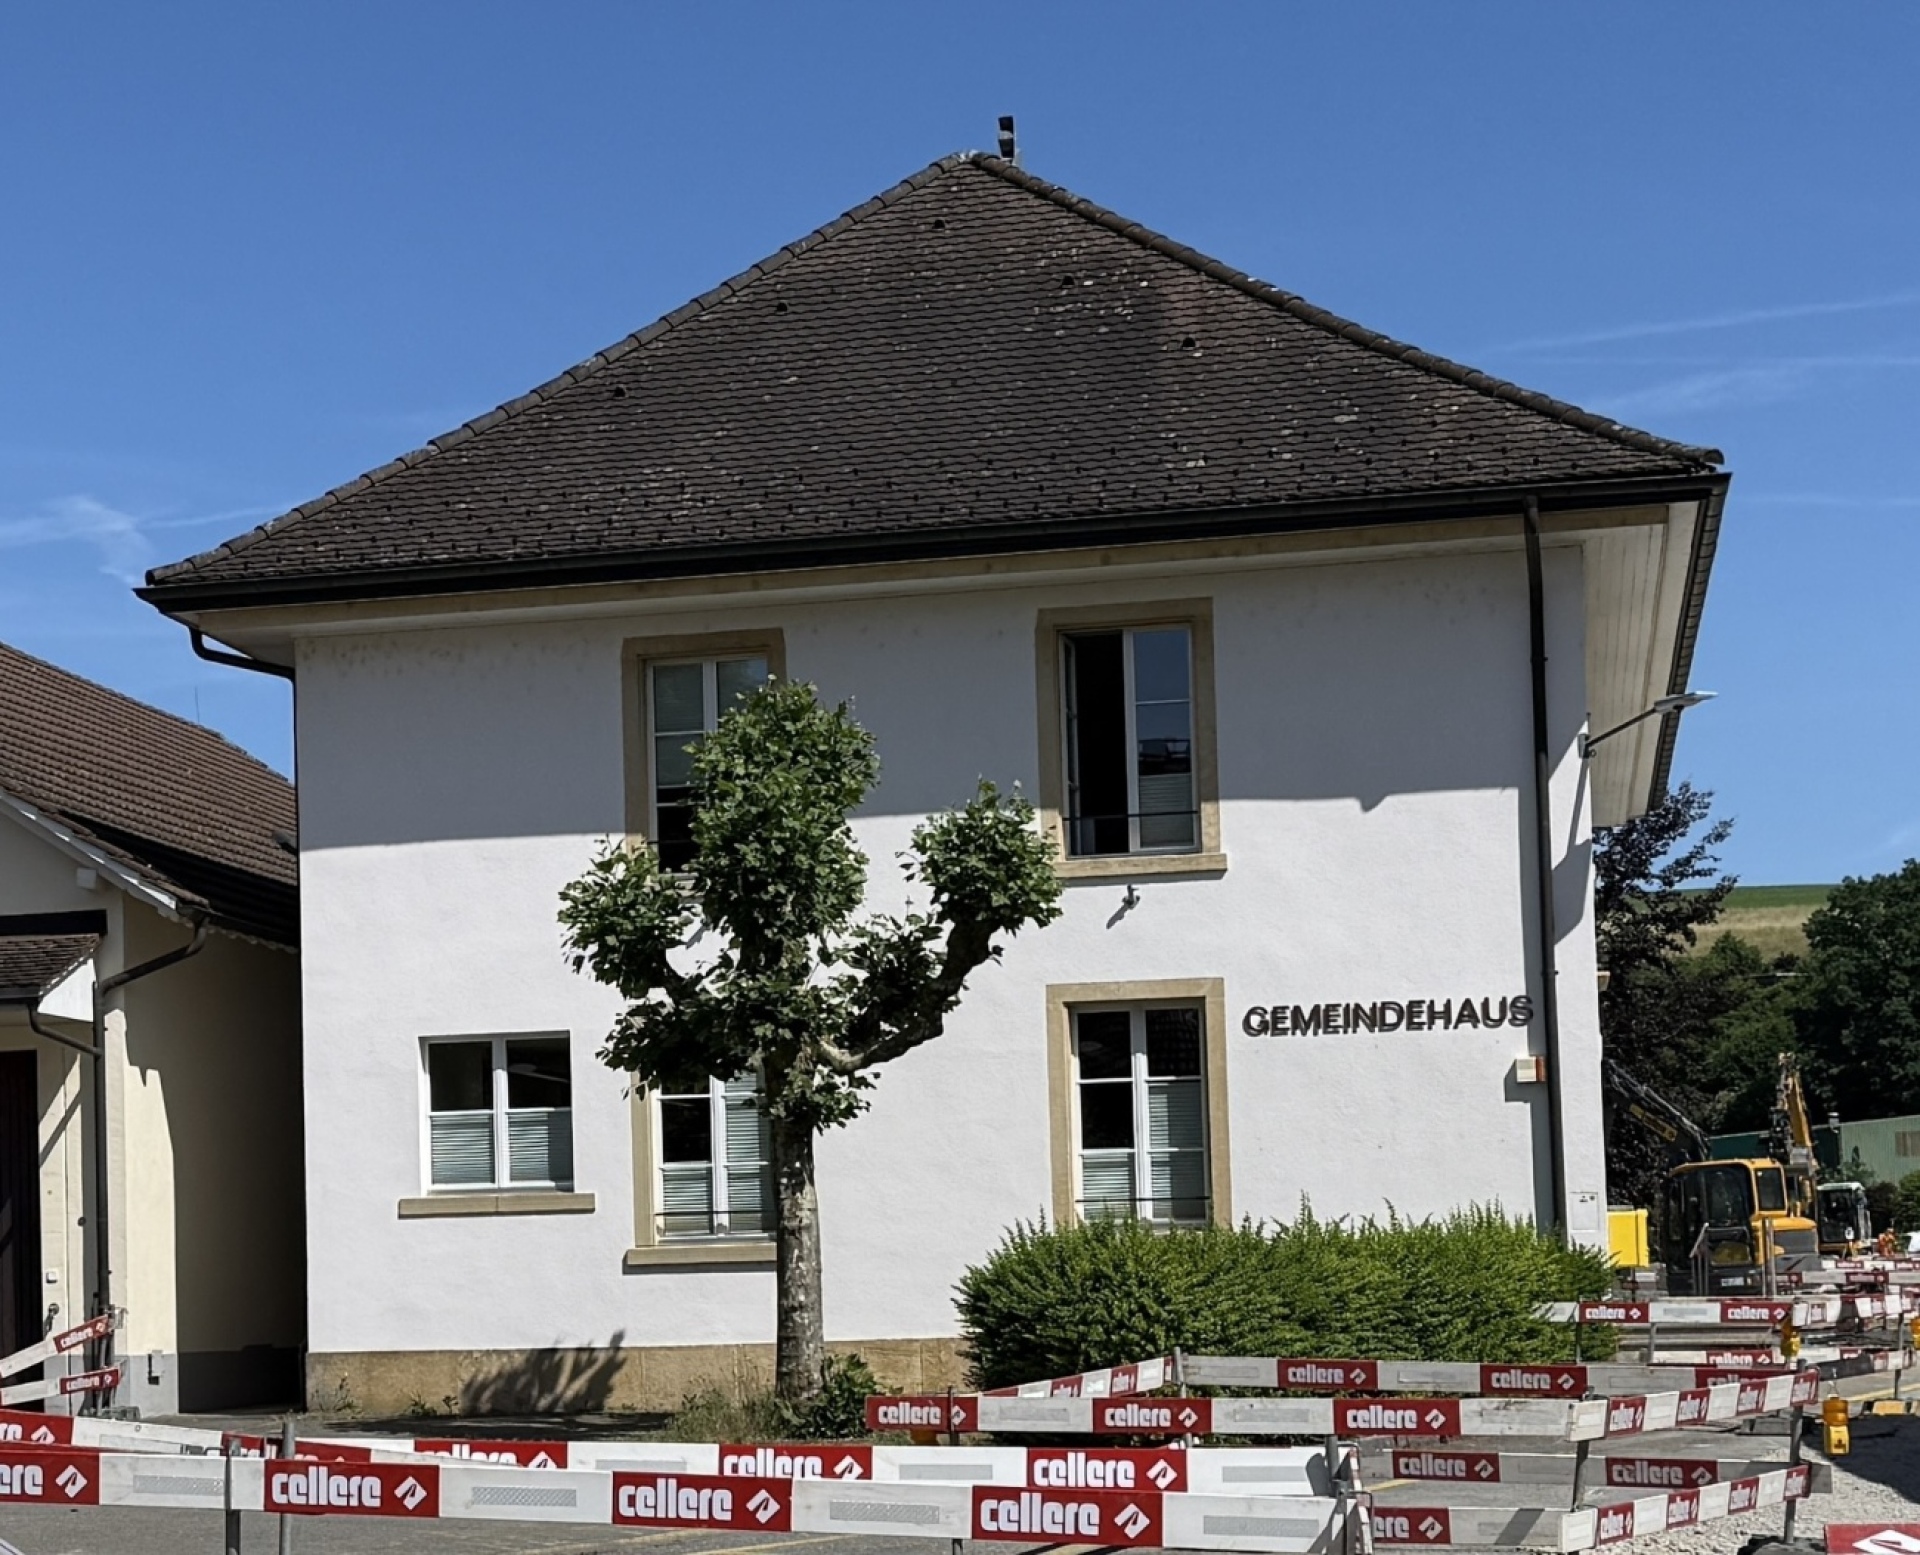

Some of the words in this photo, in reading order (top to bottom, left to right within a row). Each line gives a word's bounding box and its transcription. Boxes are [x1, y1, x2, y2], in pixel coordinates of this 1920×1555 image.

[1242, 995, 1533, 1037] GEMEINDEHAUS
[1287, 1364, 1344, 1384] cellere
[1491, 1369, 1550, 1389] cellere
[878, 1402, 942, 1425] cellere
[1104, 1403, 1171, 1427] cellere
[1346, 1405, 1417, 1428] cellere
[723, 1448, 823, 1478] cellere
[1033, 1452, 1135, 1488] cellere
[1399, 1453, 1466, 1477] cellere
[1612, 1460, 1684, 1484] cellere
[271, 1466, 381, 1507] cellere
[618, 1478, 733, 1521] cellere
[980, 1493, 1100, 1536] cellere
